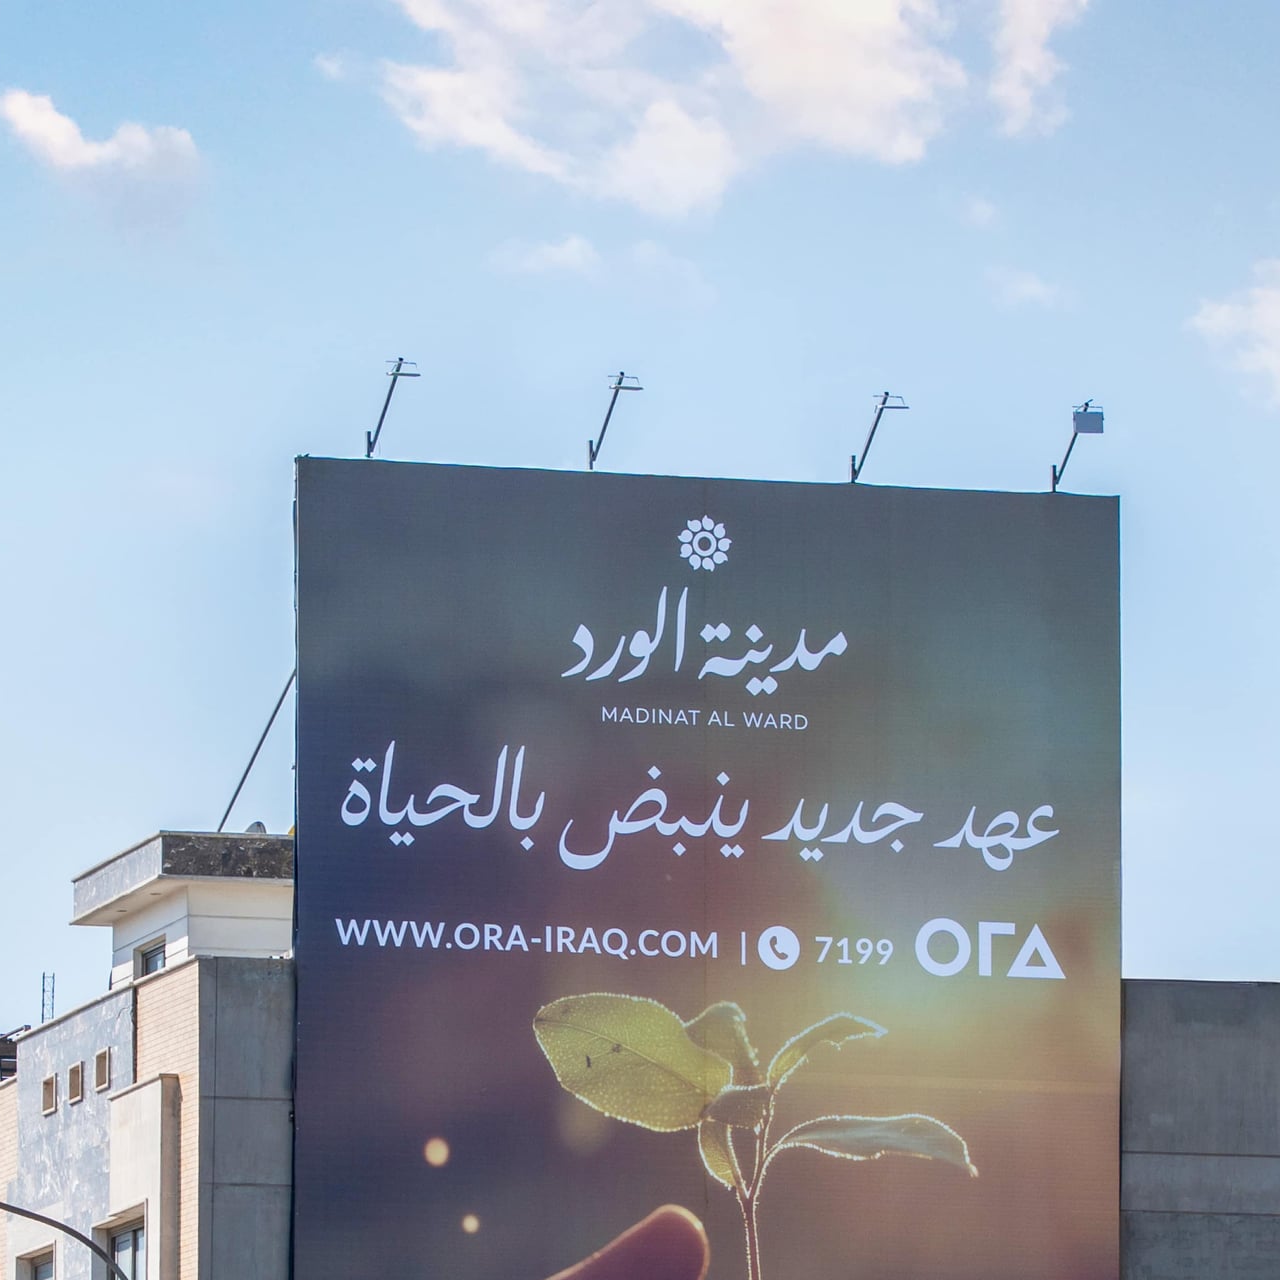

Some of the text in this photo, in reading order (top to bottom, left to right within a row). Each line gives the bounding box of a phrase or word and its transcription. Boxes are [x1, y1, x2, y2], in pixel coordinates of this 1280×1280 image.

[561, 586, 848, 695] مدينة الورد
[601, 706, 808, 731] MADINAT AL WARD
[340, 740, 1060, 871] عهد جديد ينبض بالحياة
[336, 918, 718, 960] WWW.ORA-IRAQ.COM
[815, 936, 894, 966] 7199
